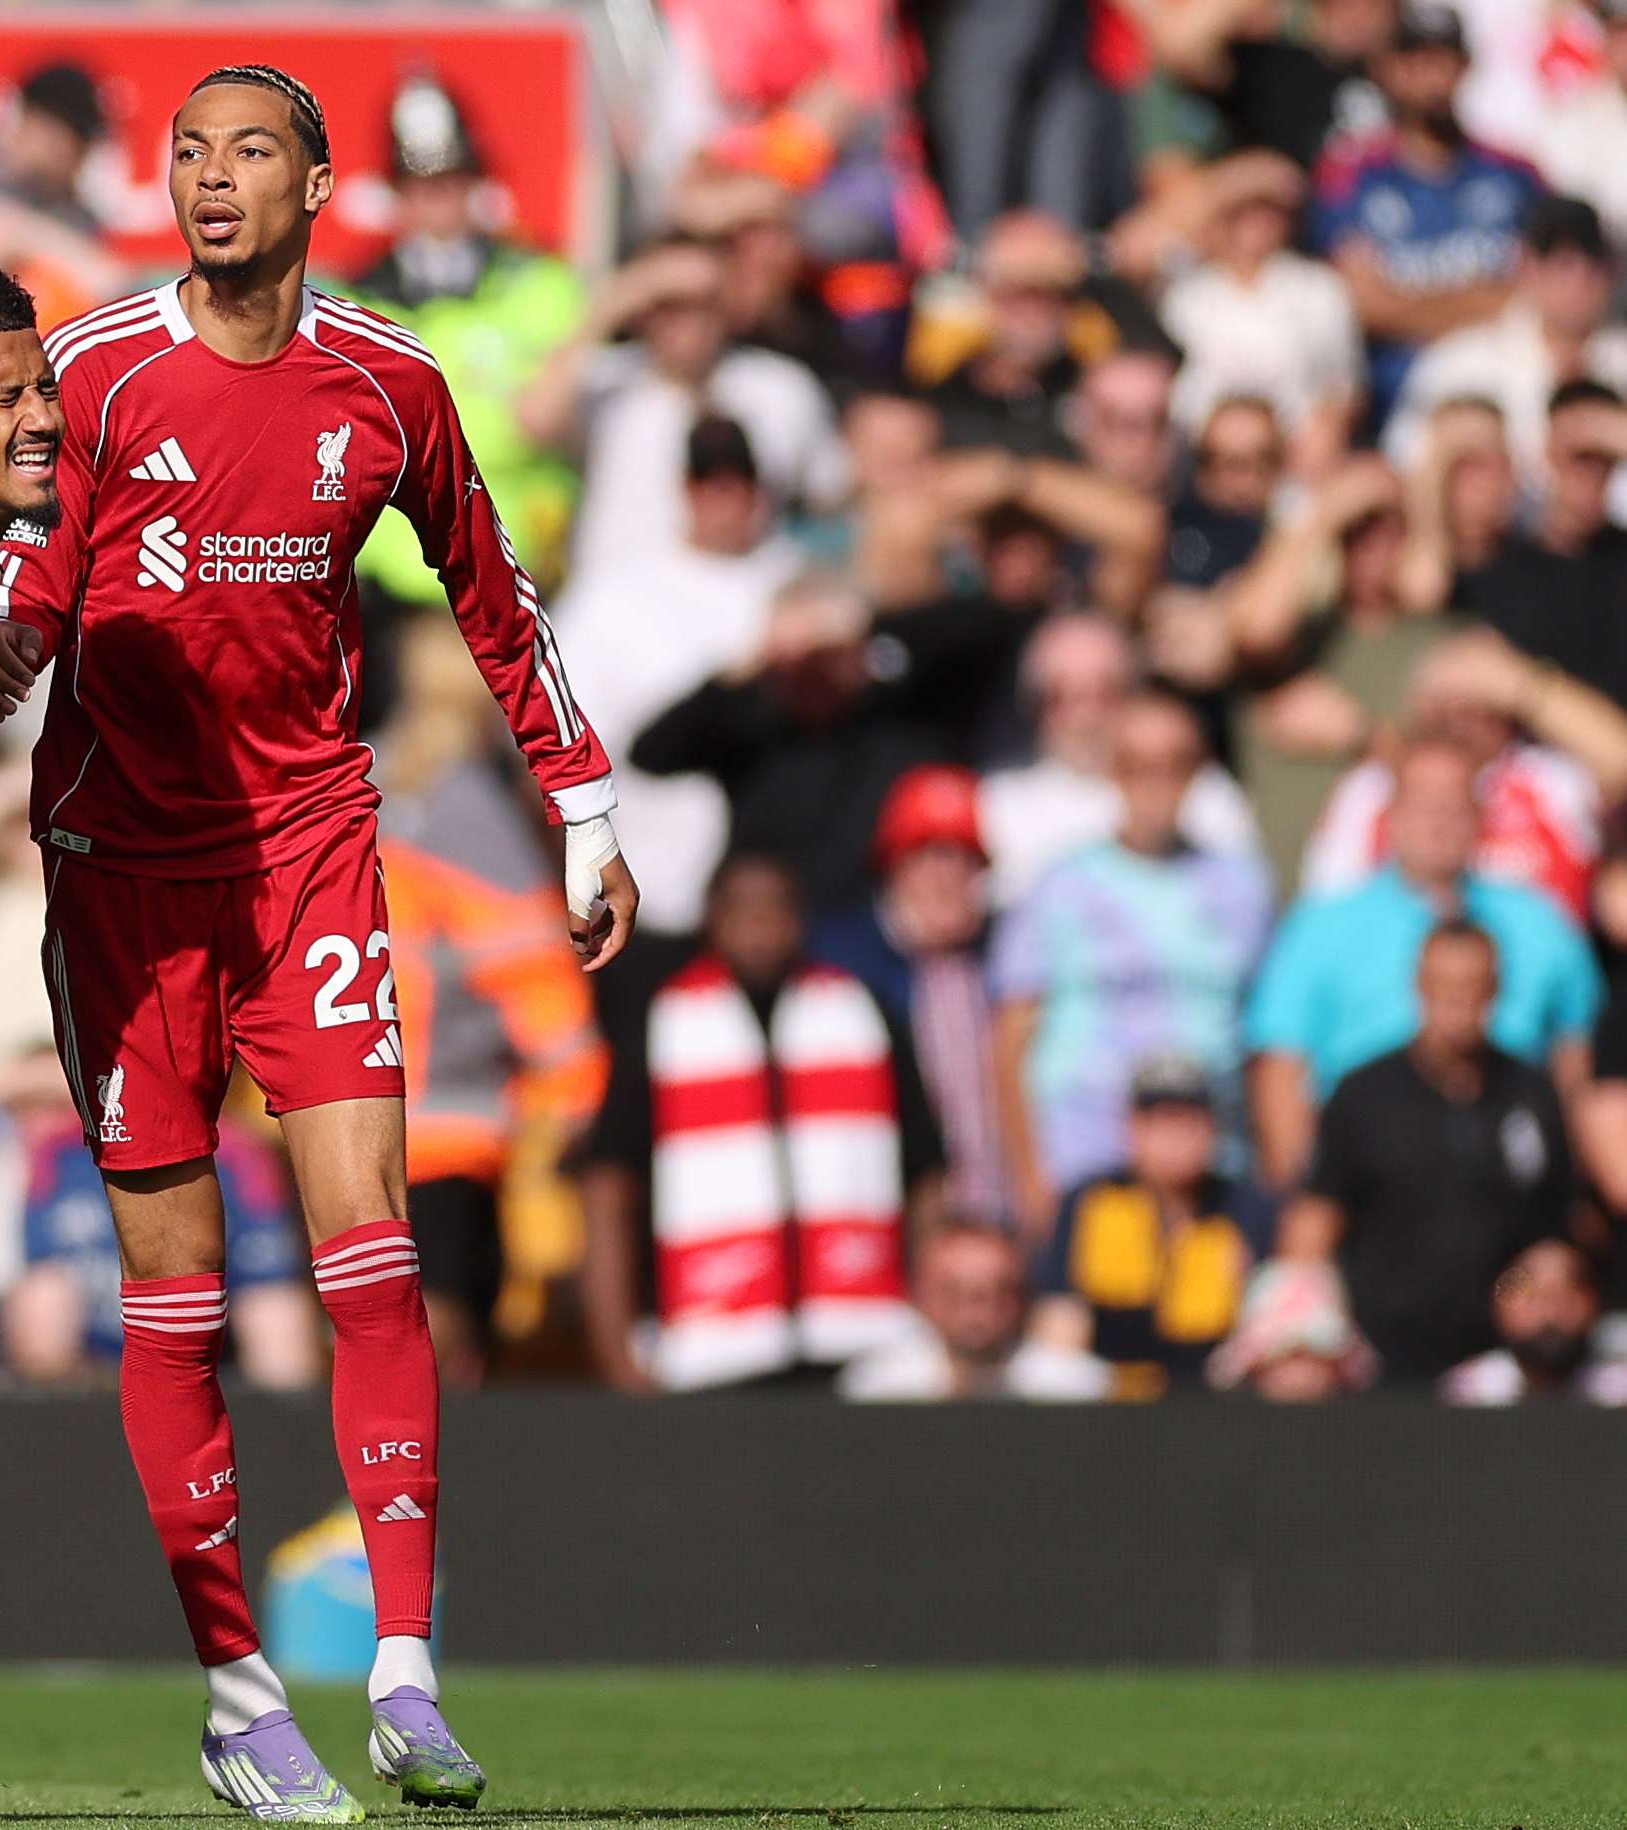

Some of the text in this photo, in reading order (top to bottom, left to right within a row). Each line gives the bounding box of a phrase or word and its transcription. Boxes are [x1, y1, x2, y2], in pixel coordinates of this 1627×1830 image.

[199, 531, 331, 557] standard
[198, 556, 331, 582] chartered
[304, 930, 398, 1030] 22
[361, 1441, 421, 1465] LFC
[186, 1467, 237, 1500] LFC
